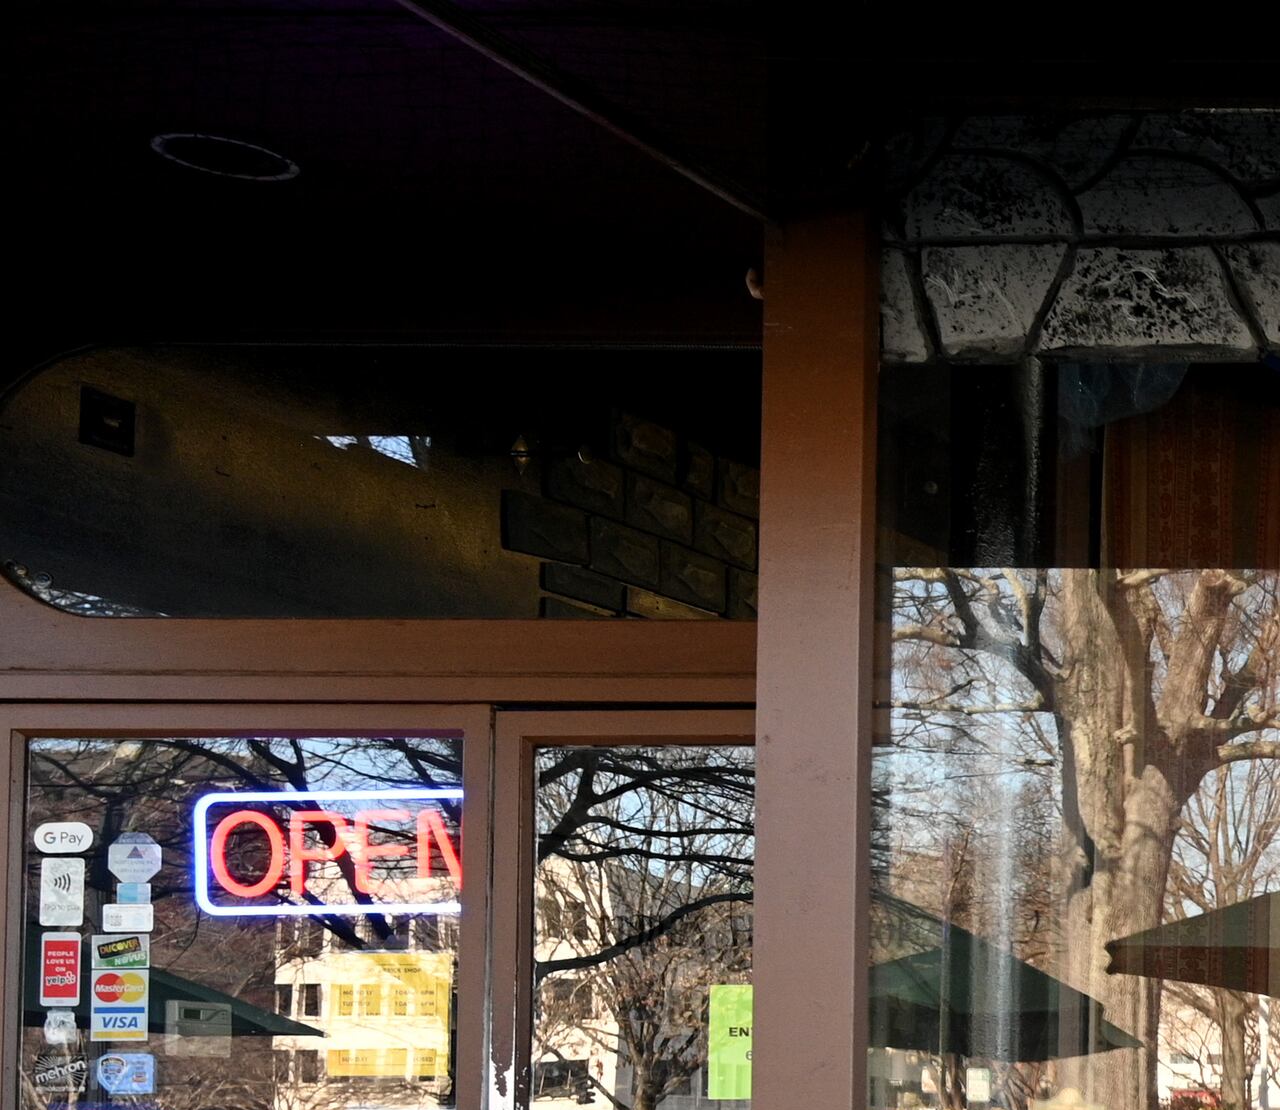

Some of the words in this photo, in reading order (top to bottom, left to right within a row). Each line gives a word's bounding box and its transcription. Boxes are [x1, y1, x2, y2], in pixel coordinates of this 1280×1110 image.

[60, 831, 84, 846] Pay
[211, 809, 463, 898] OPEN
[45, 974, 66, 986] yelp
[95, 983, 145, 993] MasterCard
[102, 1016, 138, 1029] VISA
[35, 1060, 87, 1085] mehron
